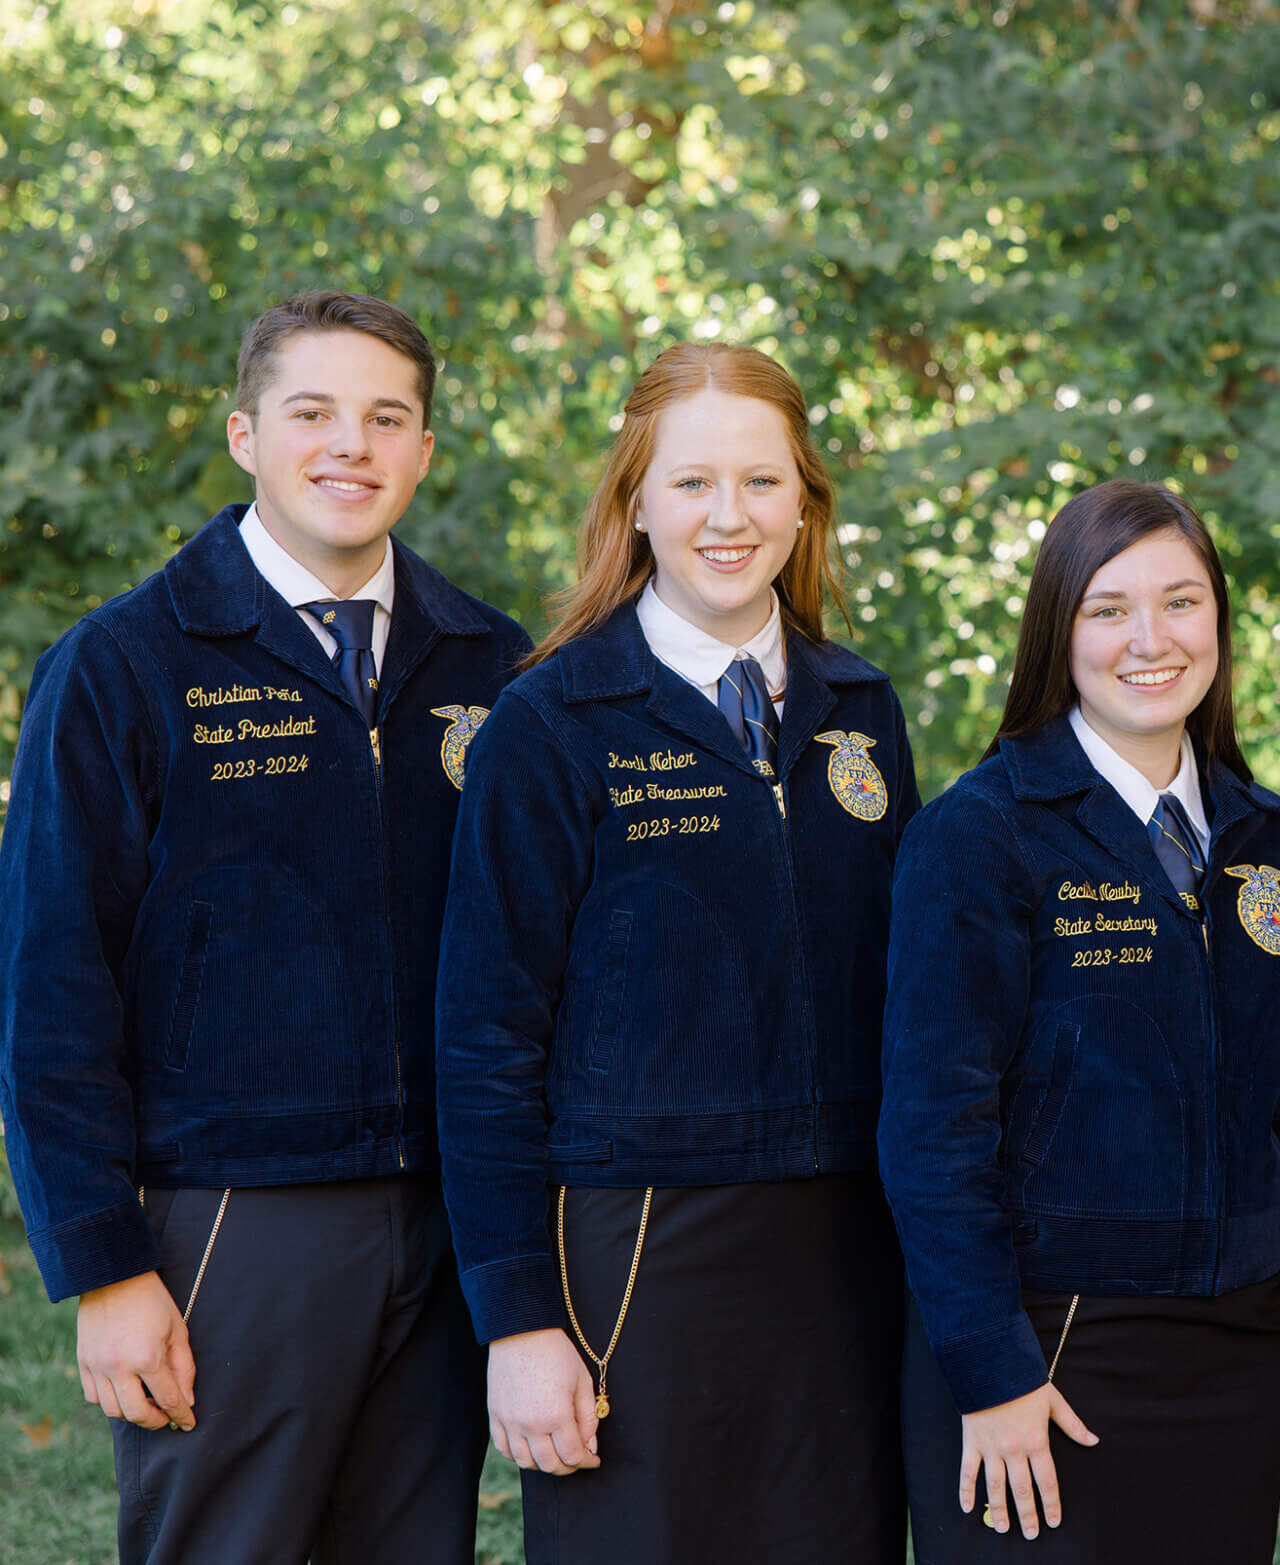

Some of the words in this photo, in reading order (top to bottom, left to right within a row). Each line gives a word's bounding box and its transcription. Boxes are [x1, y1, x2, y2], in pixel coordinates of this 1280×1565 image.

[186, 684, 262, 707] Christian
[193, 724, 234, 744] State
[238, 715, 317, 740] President
[210, 754, 310, 781] 2023-2024
[646, 783, 728, 800] Treasurer
[626, 814, 721, 841] 2023-2024
[1053, 917, 1093, 936] State
[1094, 912, 1158, 936] Secretary
[1071, 946, 1153, 967] 2023-2024
